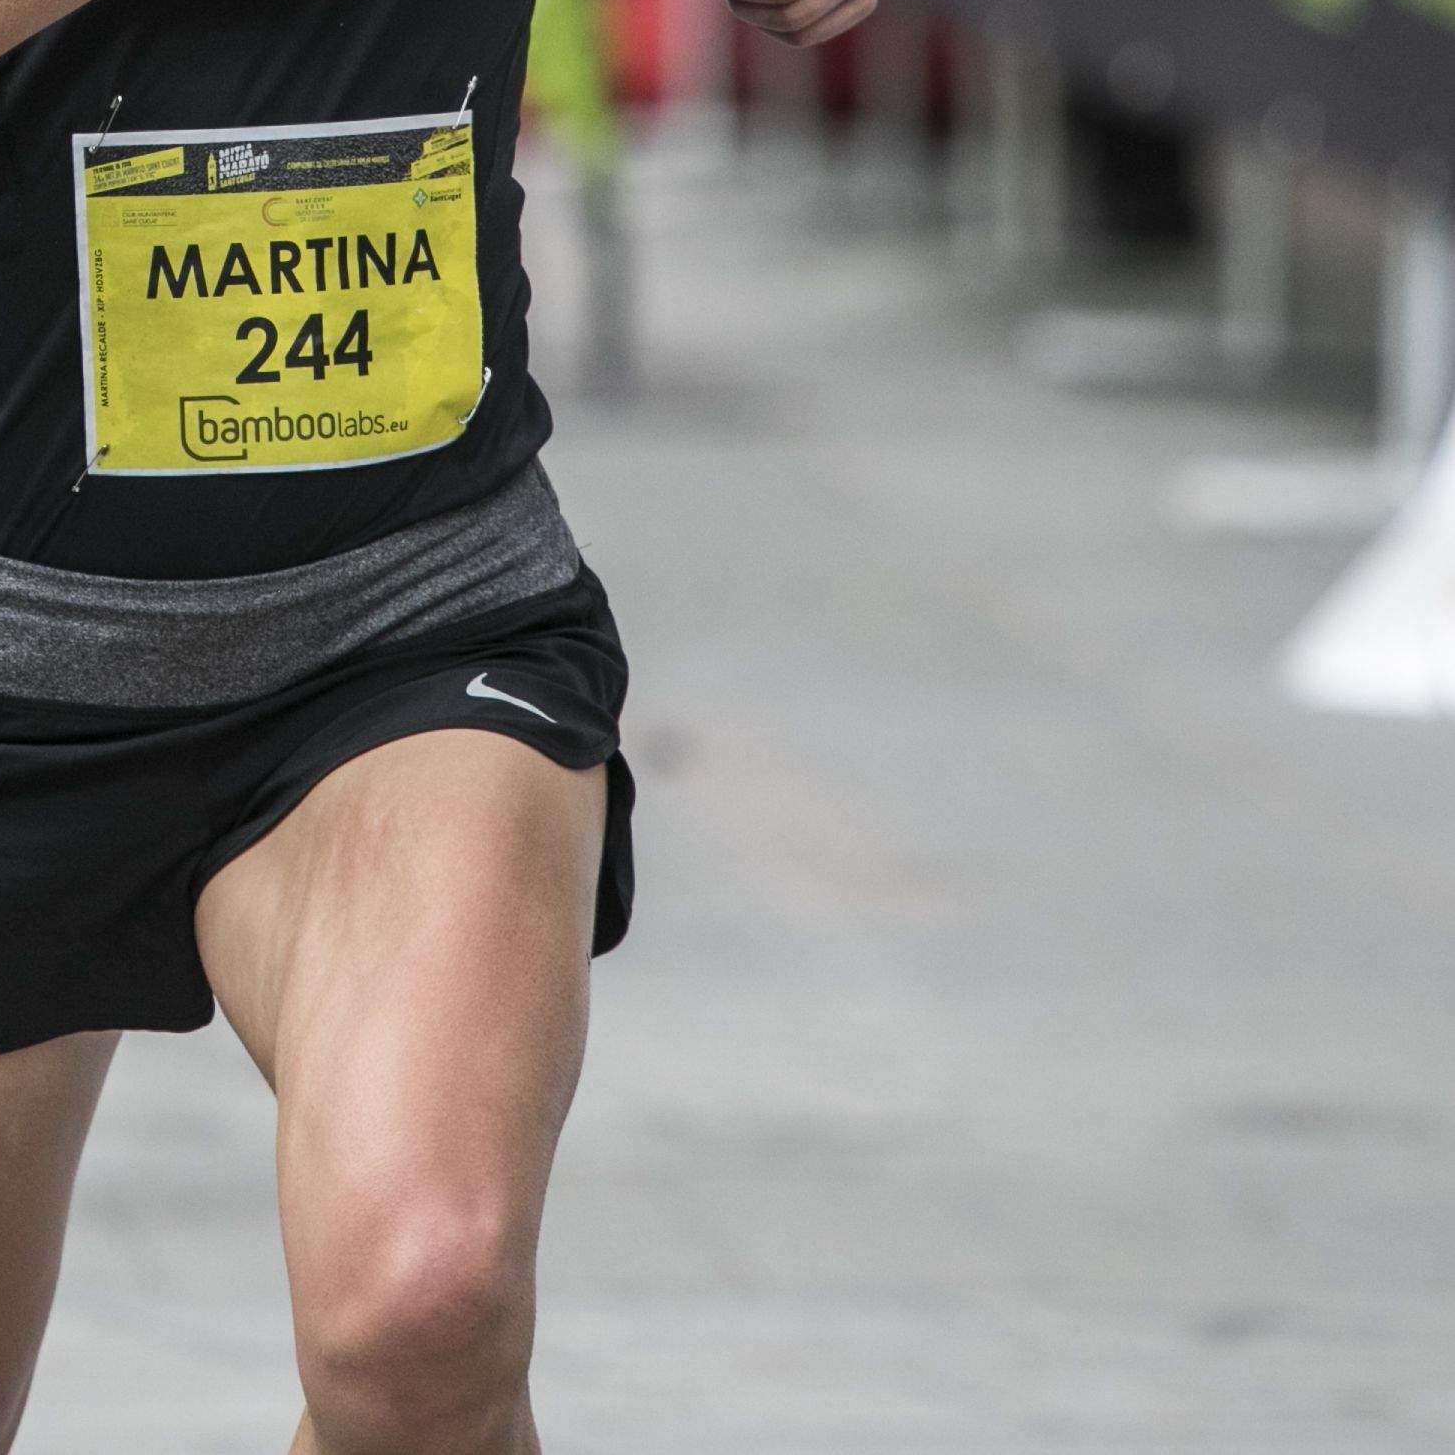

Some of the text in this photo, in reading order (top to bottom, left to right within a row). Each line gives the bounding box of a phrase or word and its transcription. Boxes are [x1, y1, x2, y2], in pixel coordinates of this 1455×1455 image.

[145, 227, 442, 300] MARTINA
[97, 321, 107, 362] RECALDE
[234, 308, 374, 385] 244
[100, 365, 109, 407] MARTINA
[198, 406, 408, 445] bamboolabs.eu
